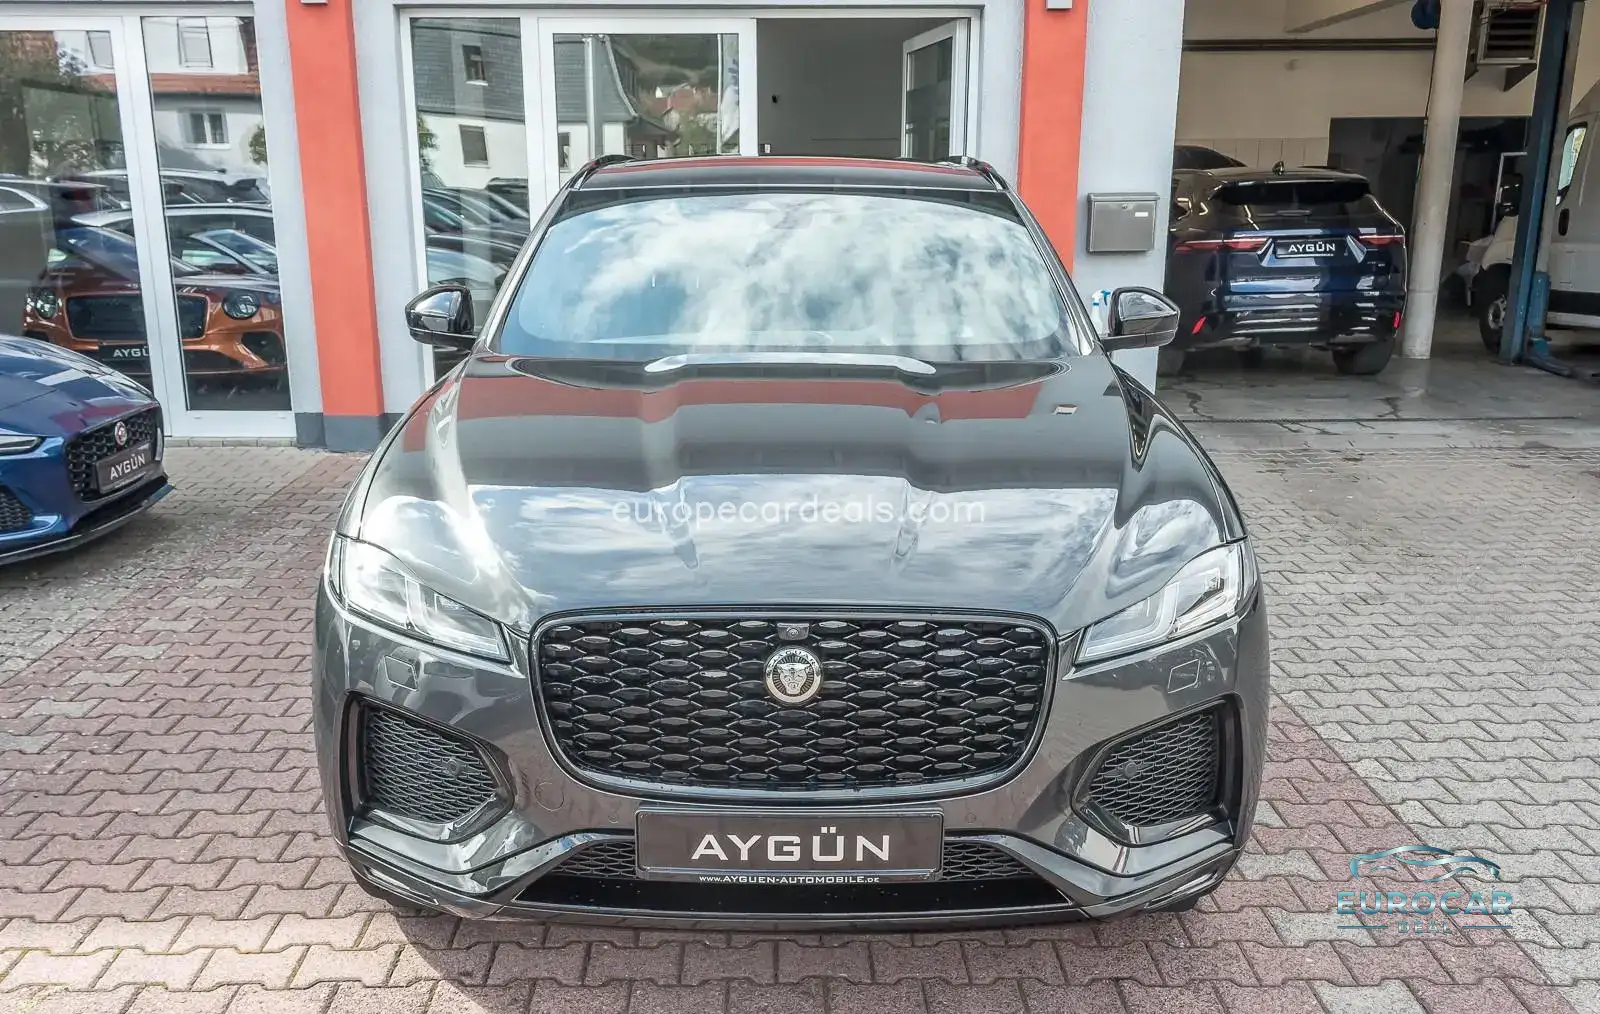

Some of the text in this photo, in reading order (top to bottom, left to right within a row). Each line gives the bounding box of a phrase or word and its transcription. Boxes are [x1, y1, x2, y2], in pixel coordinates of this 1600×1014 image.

[1288, 241, 1336, 253] AYGÜN
[113, 346, 150, 358] AYGÜ
[110, 452, 146, 480] AYGÜN
[691, 826, 890, 862] AYGÜN
